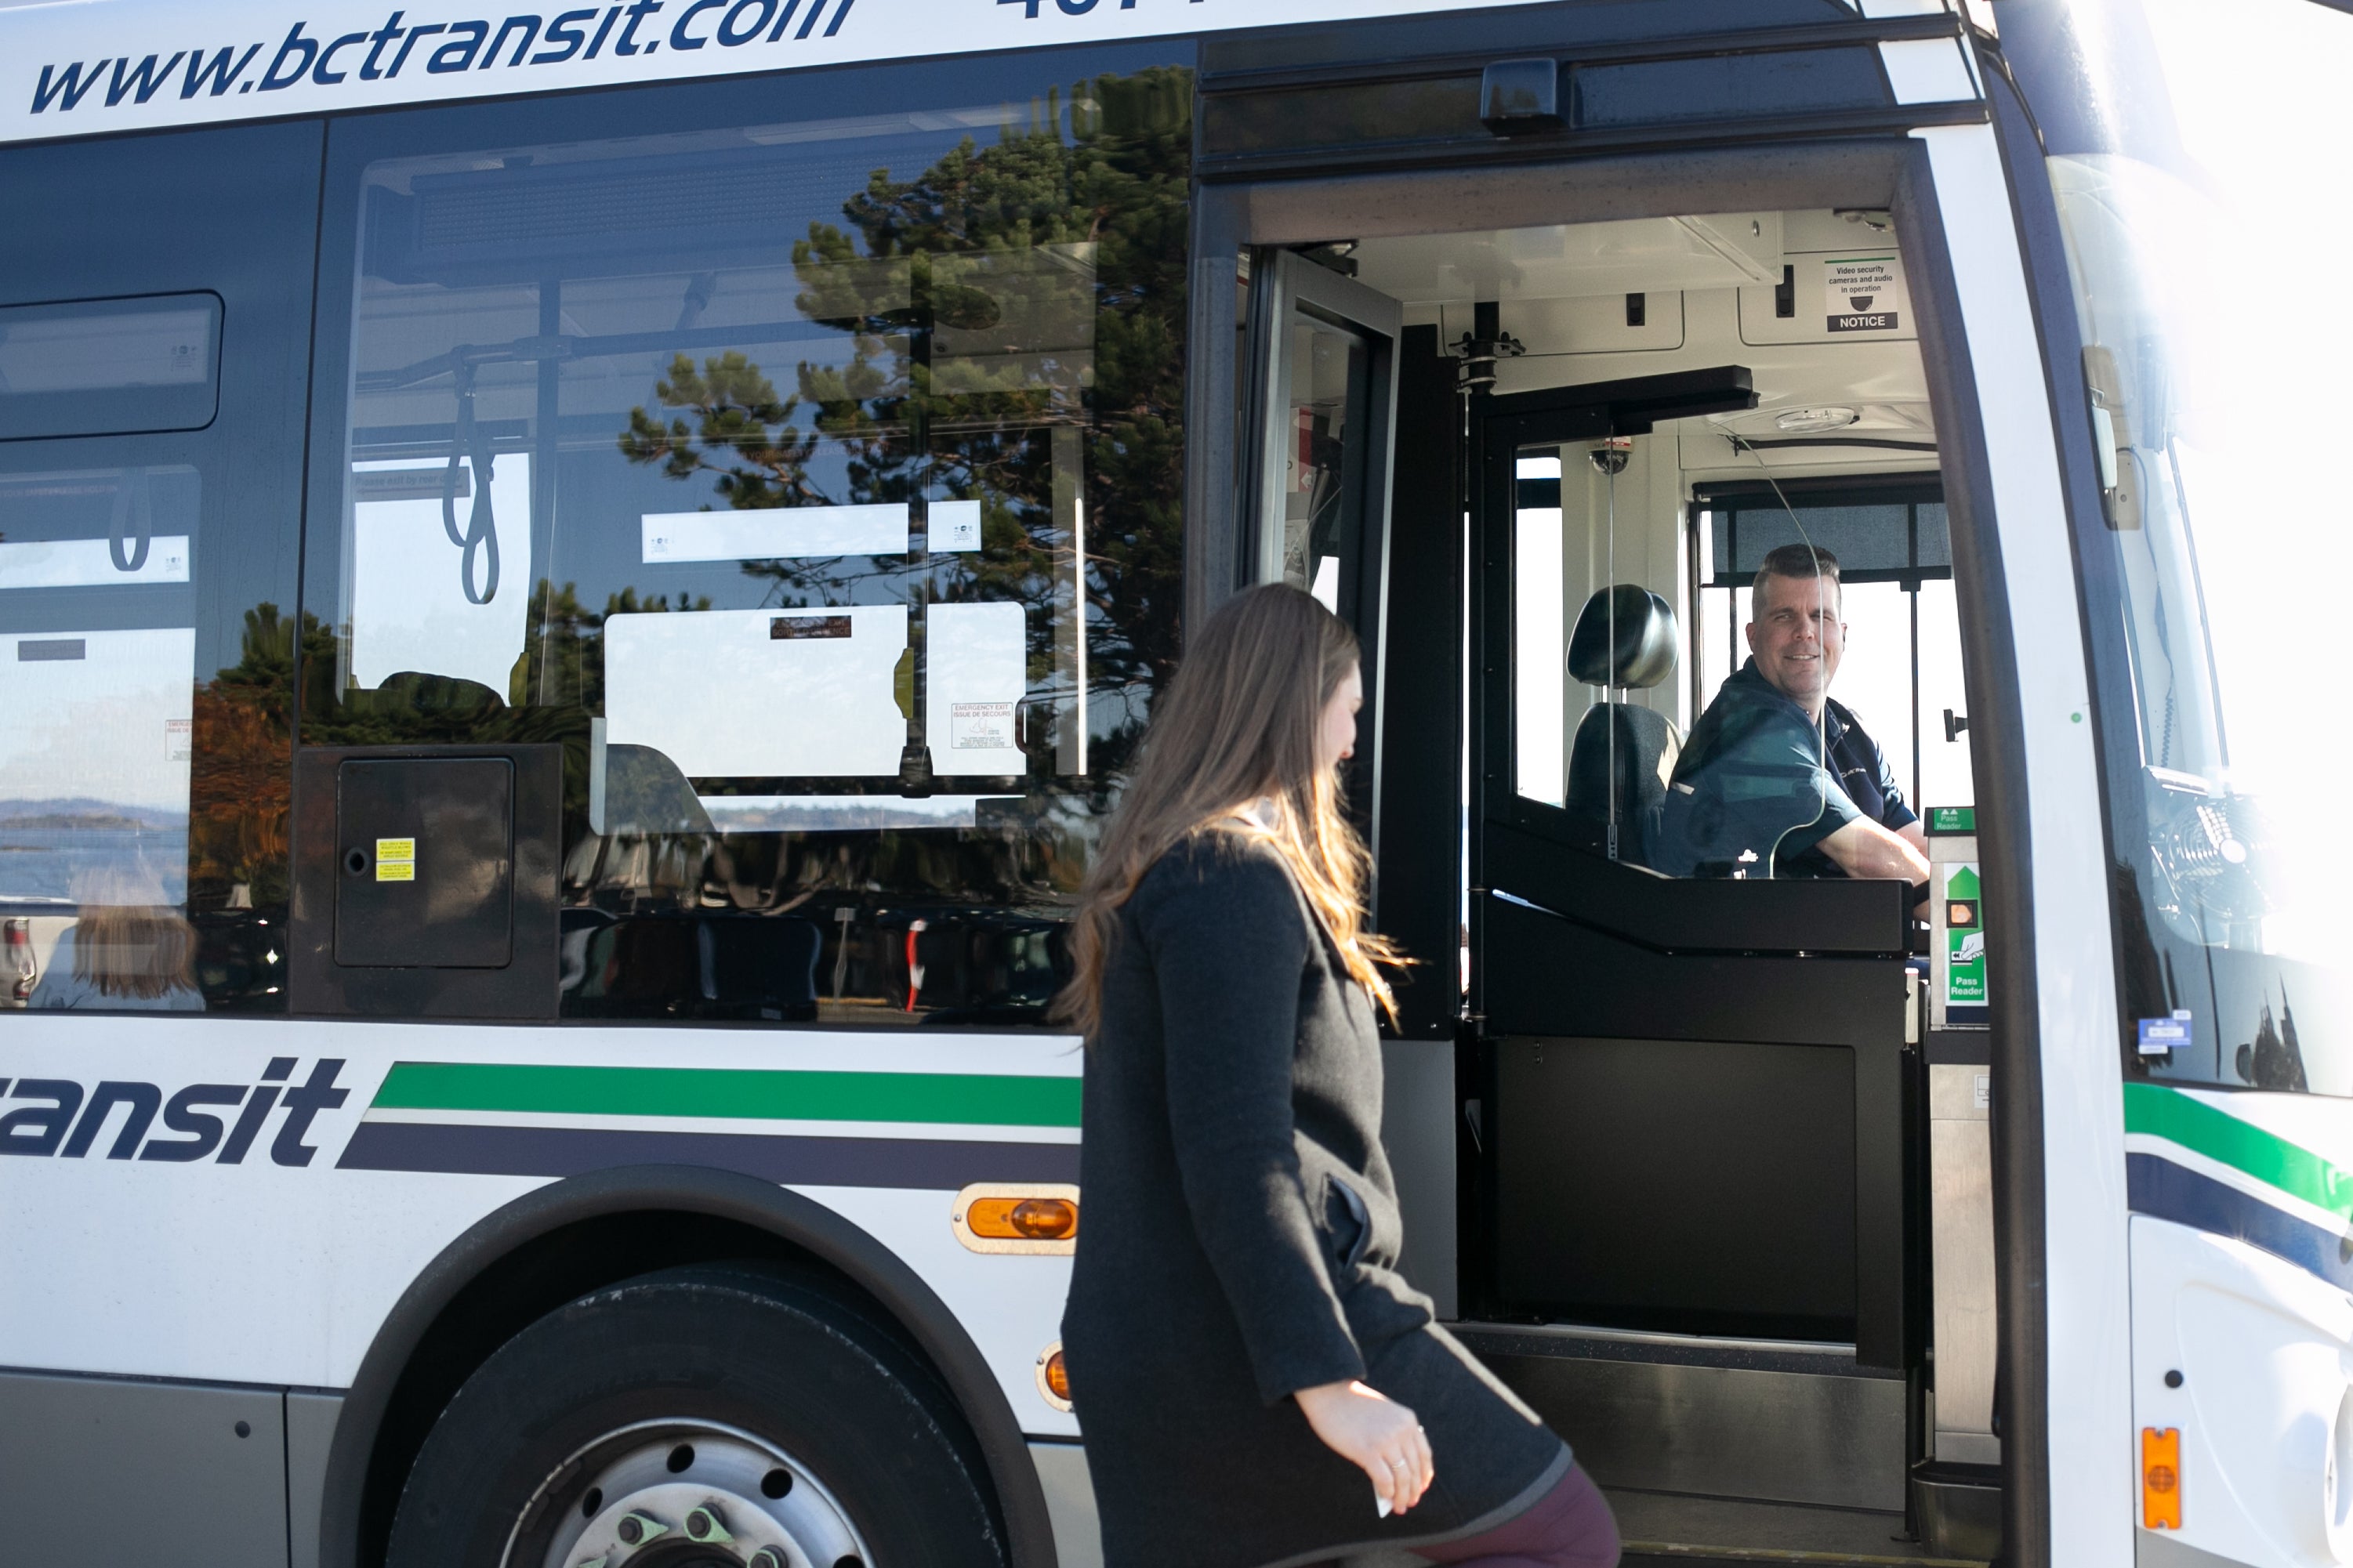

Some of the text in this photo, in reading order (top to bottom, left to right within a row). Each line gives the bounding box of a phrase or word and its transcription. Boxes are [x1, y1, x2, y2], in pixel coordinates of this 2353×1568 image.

[30, 0, 854, 114] www.bctransit.com
[1849, 285, 1881, 294] operation
[1840, 316, 1886, 328] NOTICE
[1956, 976, 1978, 985] Pass
[1951, 987, 1983, 995] Reader
[0, 1056, 350, 1168] ansit
